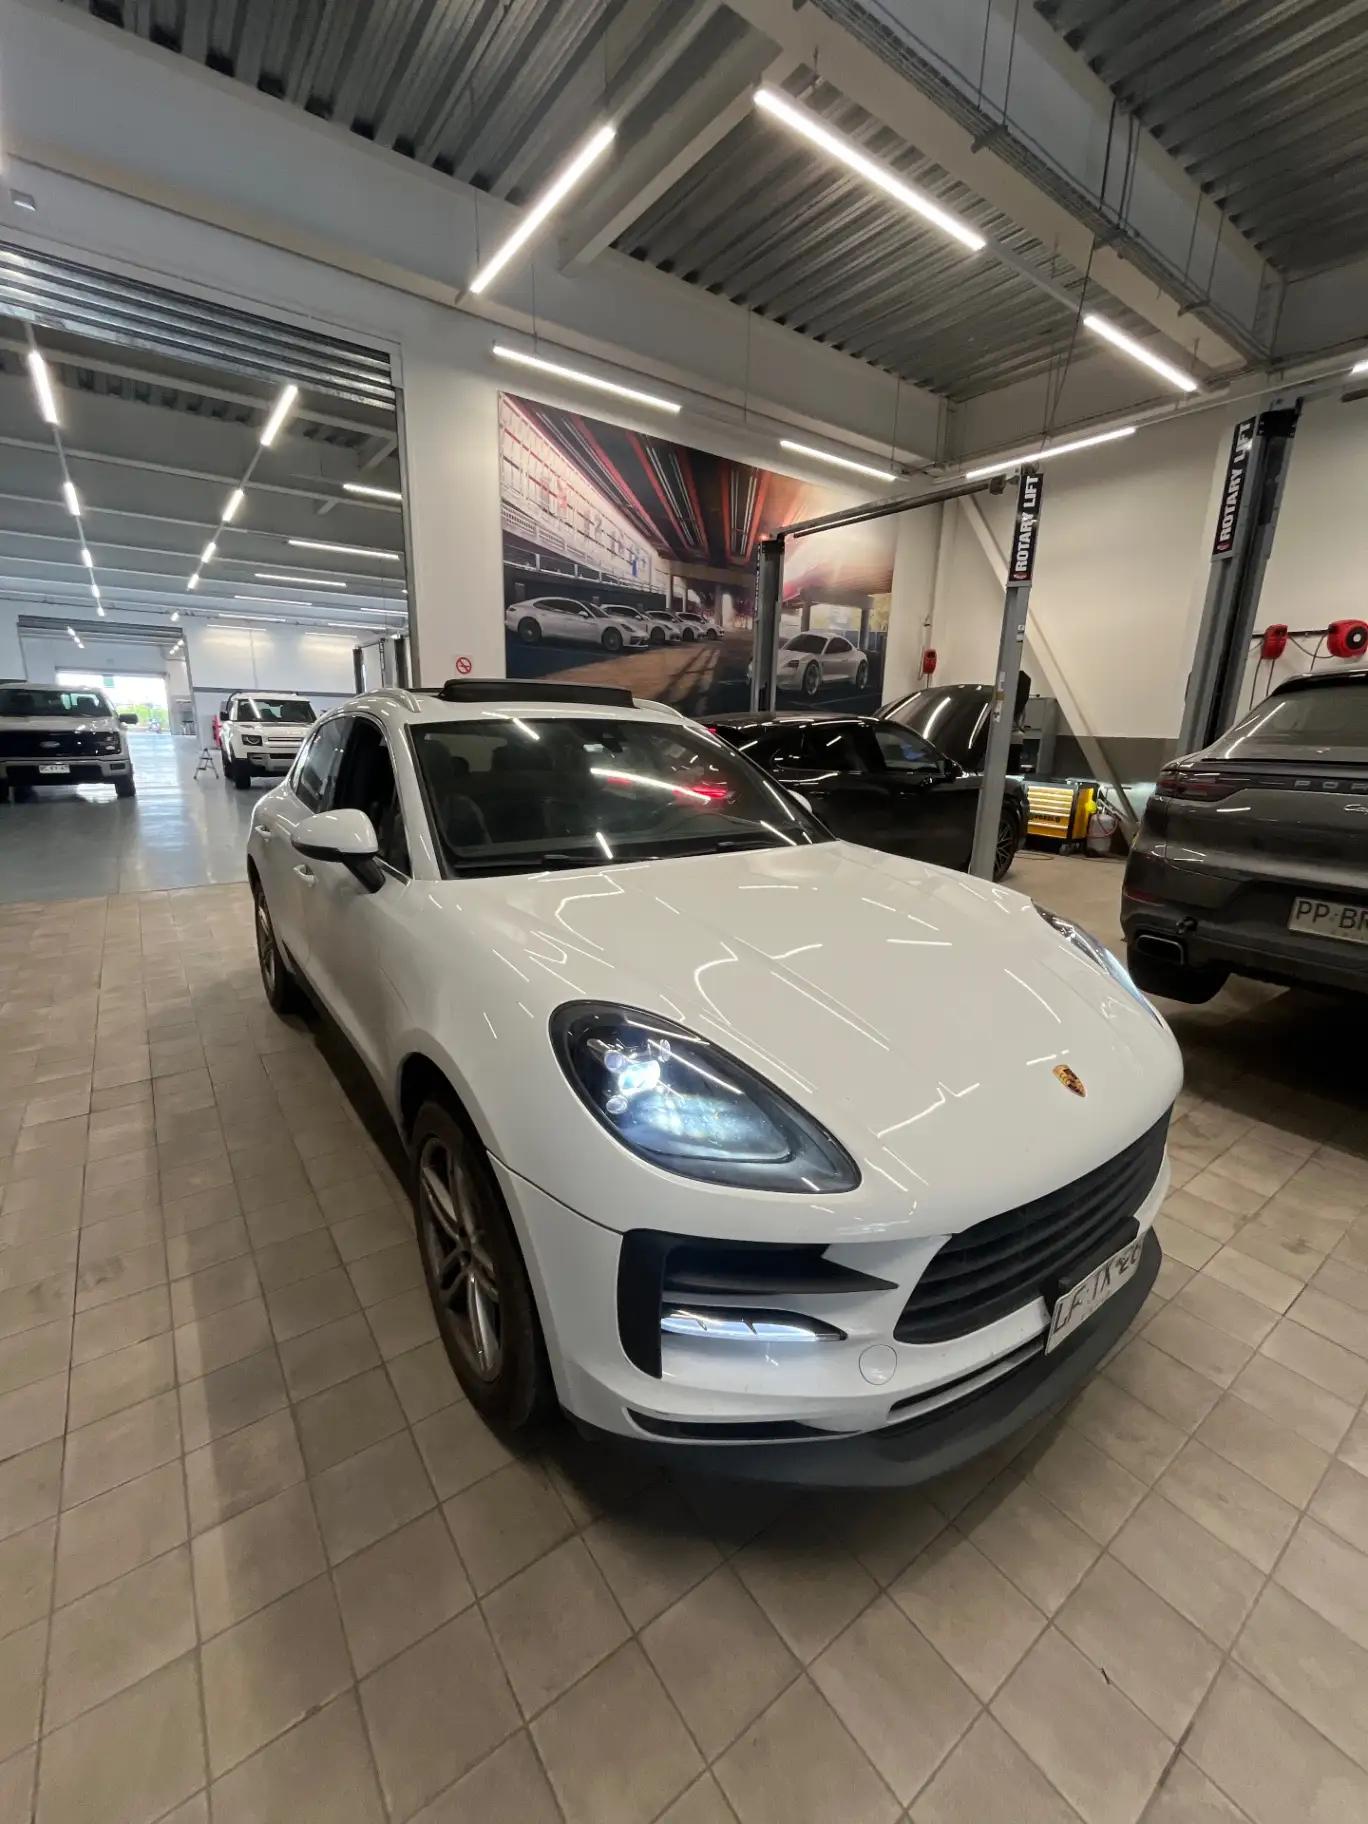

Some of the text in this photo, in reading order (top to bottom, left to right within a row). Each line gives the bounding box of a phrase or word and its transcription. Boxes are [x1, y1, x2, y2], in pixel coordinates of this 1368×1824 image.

[1015, 475, 1039, 572] ROTARY LIFT
[1219, 422, 1252, 541] ROTARY LIFT
